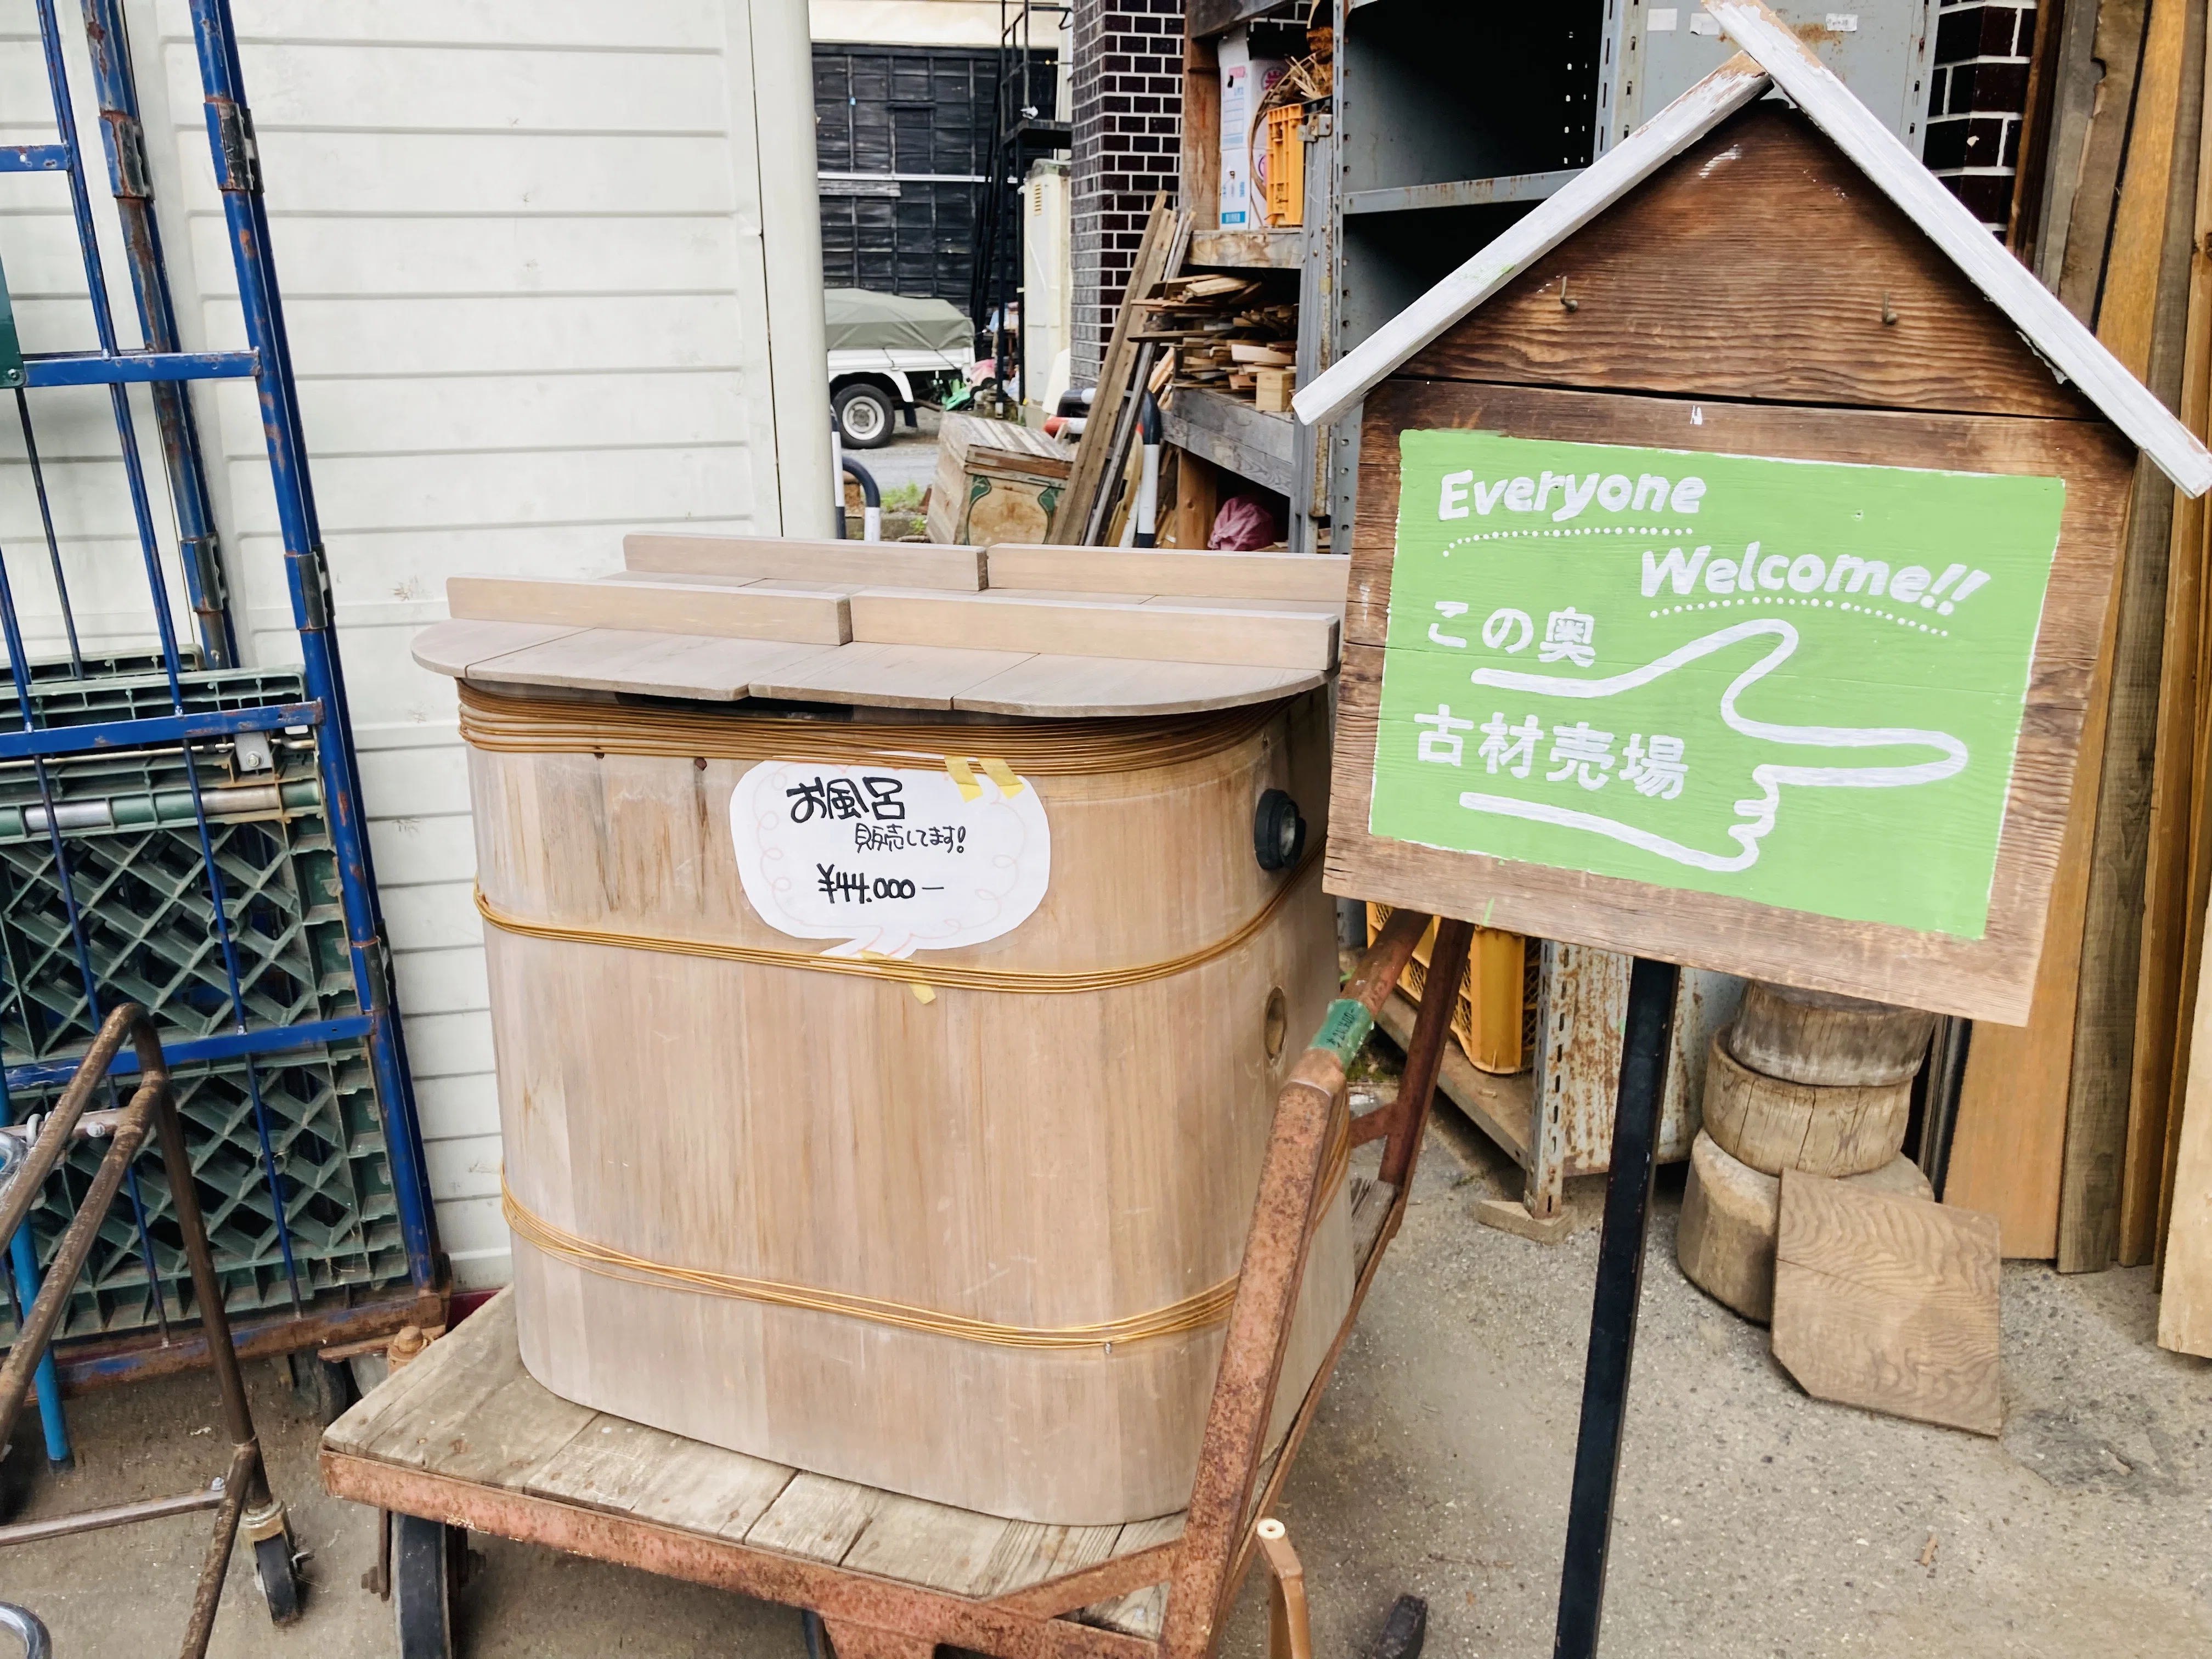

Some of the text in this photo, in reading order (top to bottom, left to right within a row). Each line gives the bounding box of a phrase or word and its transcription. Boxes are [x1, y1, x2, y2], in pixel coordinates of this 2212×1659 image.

[1438, 469, 1707, 522] Everyone
[1640, 540, 1991, 616] Welcome!!
[1427, 601, 1596, 668] この奥
[1414, 703, 1689, 800] 古材売場
[786, 776, 906, 823] お風呂
